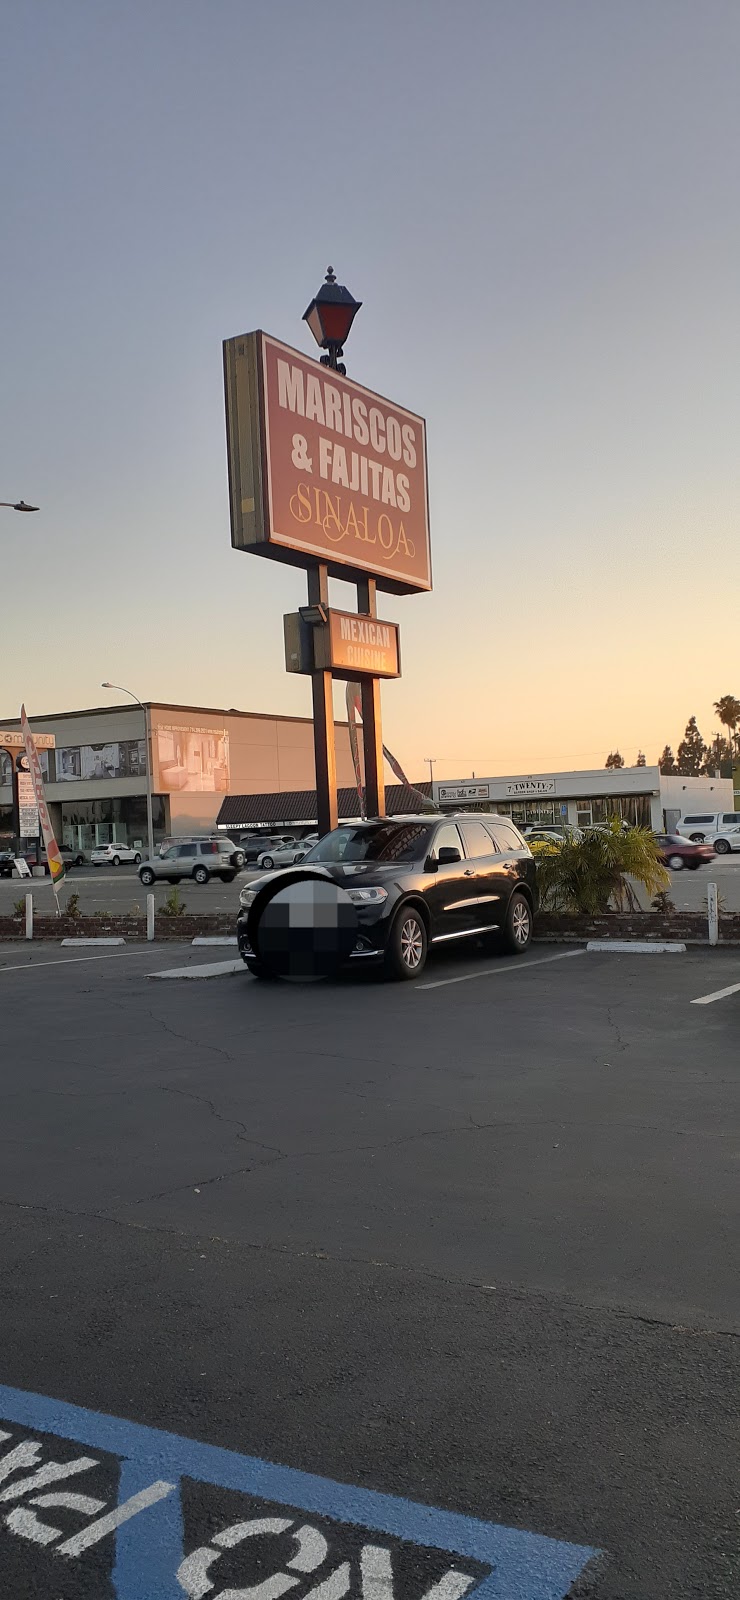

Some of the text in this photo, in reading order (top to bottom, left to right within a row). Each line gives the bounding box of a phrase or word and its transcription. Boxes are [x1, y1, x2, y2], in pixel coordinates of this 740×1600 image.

[277, 358, 417, 468] MARISCOS
[291, 433, 411, 513] & FAJITAS
[289, 482, 416, 560] SINALOA
[340, 617, 391, 648] MEXICAN
[346, 645, 387, 671] CUISINE
